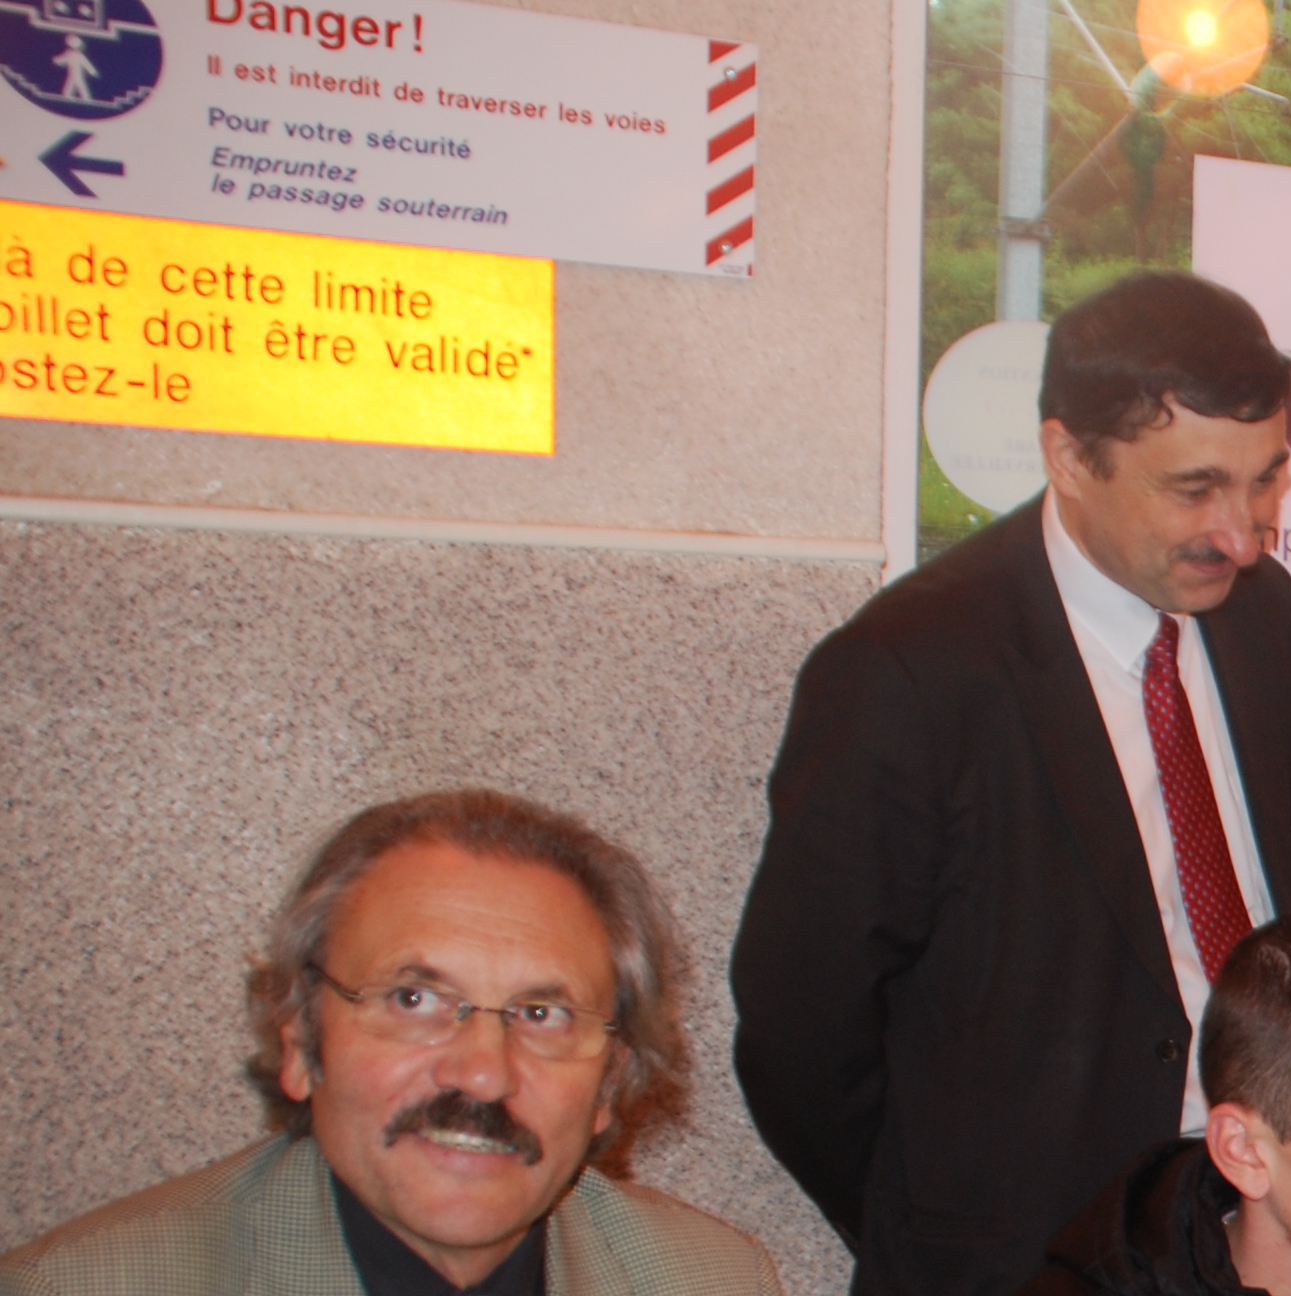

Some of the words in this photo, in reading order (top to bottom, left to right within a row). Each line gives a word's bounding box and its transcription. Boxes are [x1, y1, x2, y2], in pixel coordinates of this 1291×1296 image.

[208, 54, 222, 76] Il
[234, 63, 277, 84] est
[290, 66, 381, 98] interdit
[394, 82, 425, 104] de
[437, 87, 548, 120] traverser
[559, 102, 594, 126] les
[605, 111, 667, 135] voies
[207, 107, 270, 133] Pour
[284, 121, 353, 145] votre
[366, 130, 472, 159] sécurité
[210, 146, 358, 183] Empruntez
[211, 173, 236, 195] le
[247, 181, 366, 212] passage
[376, 196, 509, 225] souterrain
[67, 243, 129, 288] de
[160, 262, 285, 304] cette
[313, 269, 433, 320] limite
[143, 308, 233, 354] doit
[265, 319, 357, 366] être
